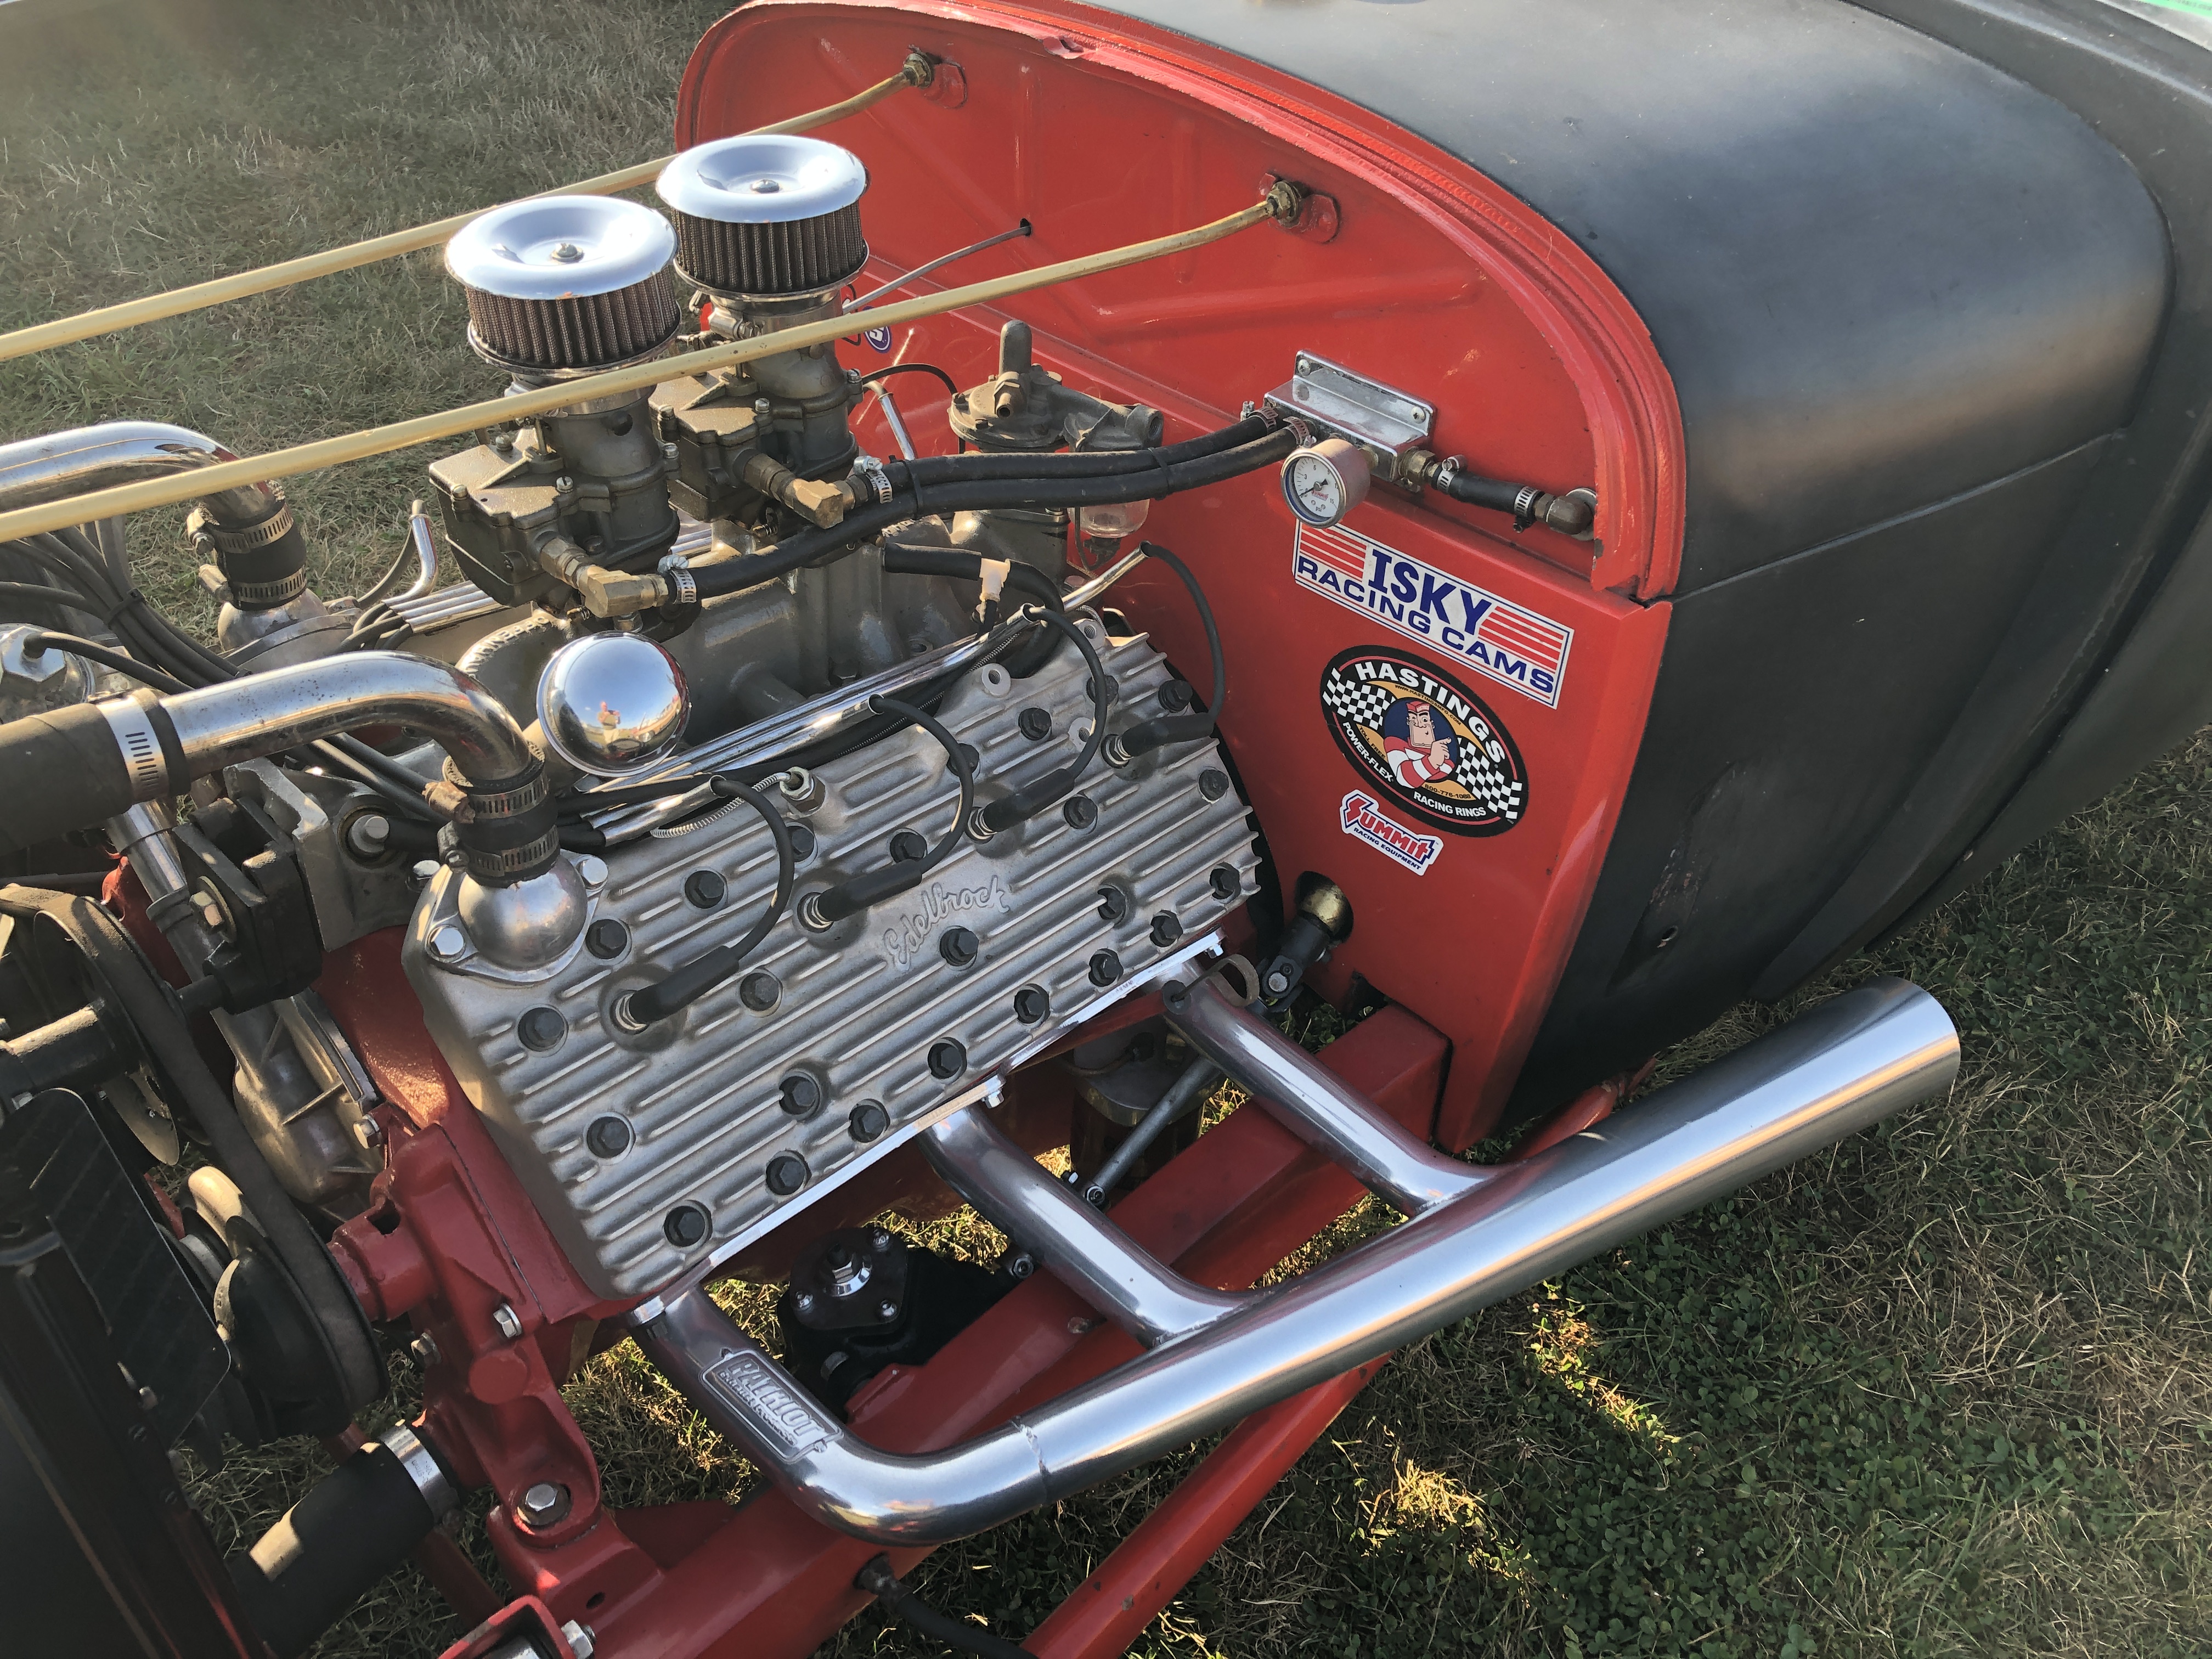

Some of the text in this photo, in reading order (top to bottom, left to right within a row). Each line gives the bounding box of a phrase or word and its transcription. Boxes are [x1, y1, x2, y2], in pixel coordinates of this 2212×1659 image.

[1297, 556, 1555, 694] RACING CAMS
[1368, 549, 1492, 635] ISKY
[1342, 721, 1393, 782] POWER-FLEX
[1355, 661, 1505, 764] HASTINGS
[1359, 726, 1386, 759] TOLL FREE
[1414, 791, 1486, 817] RACING RINGS
[1353, 827, 1421, 870] RACING EQUIPMENT
[883, 874, 1010, 971] Edelbrock
[728, 1358, 826, 1436] PATRIOT
